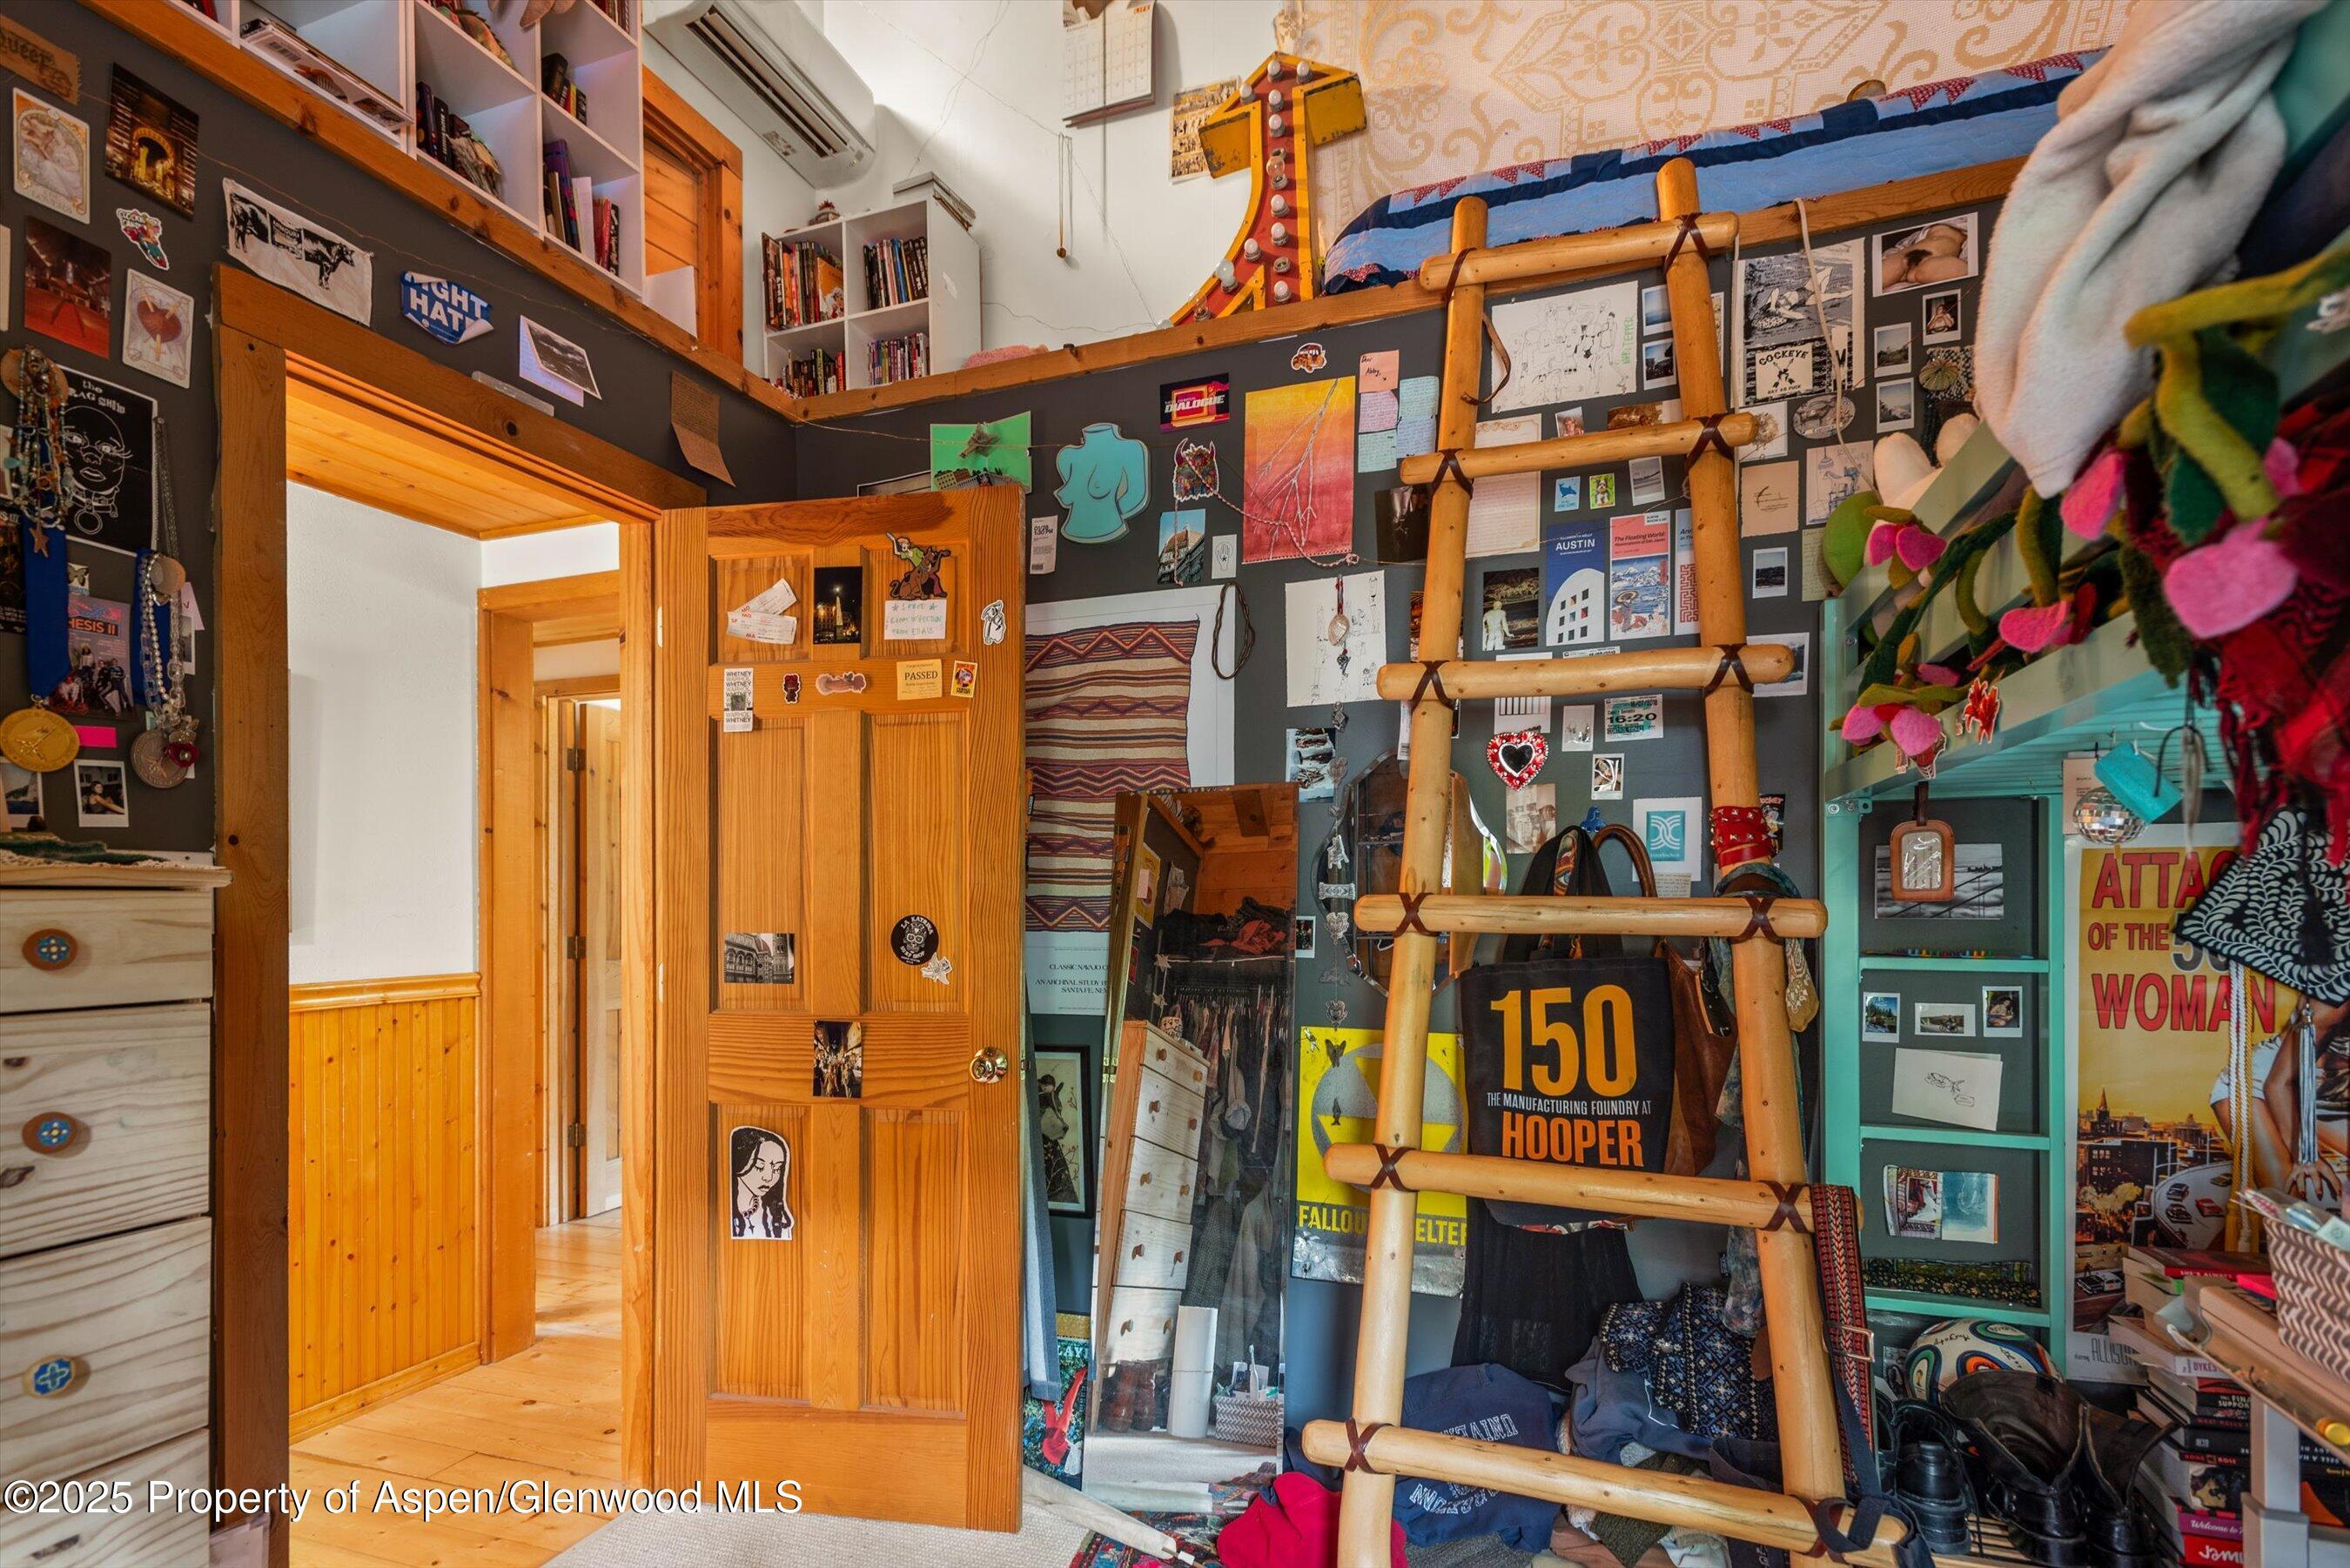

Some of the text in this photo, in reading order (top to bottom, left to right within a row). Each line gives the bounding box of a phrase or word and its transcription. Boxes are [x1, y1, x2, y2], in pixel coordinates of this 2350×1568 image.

[409, 287, 467, 332] HAT
[420, 280, 489, 319] IGHT
[1758, 350, 1810, 365] COCKEYE
[1164, 394, 1225, 414] DIALOGUE
[1555, 538, 1595, 551] AUSTIN
[904, 671, 938, 680] PASSED
[1607, 713, 1657, 724] 16:20
[2088, 922, 2119, 951] OF
[2125, 922, 2170, 951] THE
[2092, 973, 2276, 1034] WOMAN
[1490, 984, 1637, 1097] 150
[1487, 1092, 1652, 1116] THE MANUFACTURING FOUNDRY AT
[1501, 1110, 1644, 1168] HOOPER
[1299, 1204, 1467, 1246] FALLOU ELTER
[2192, 1362, 2218, 1372] DYKES
[2191, 1519, 2228, 1532] Welcome
